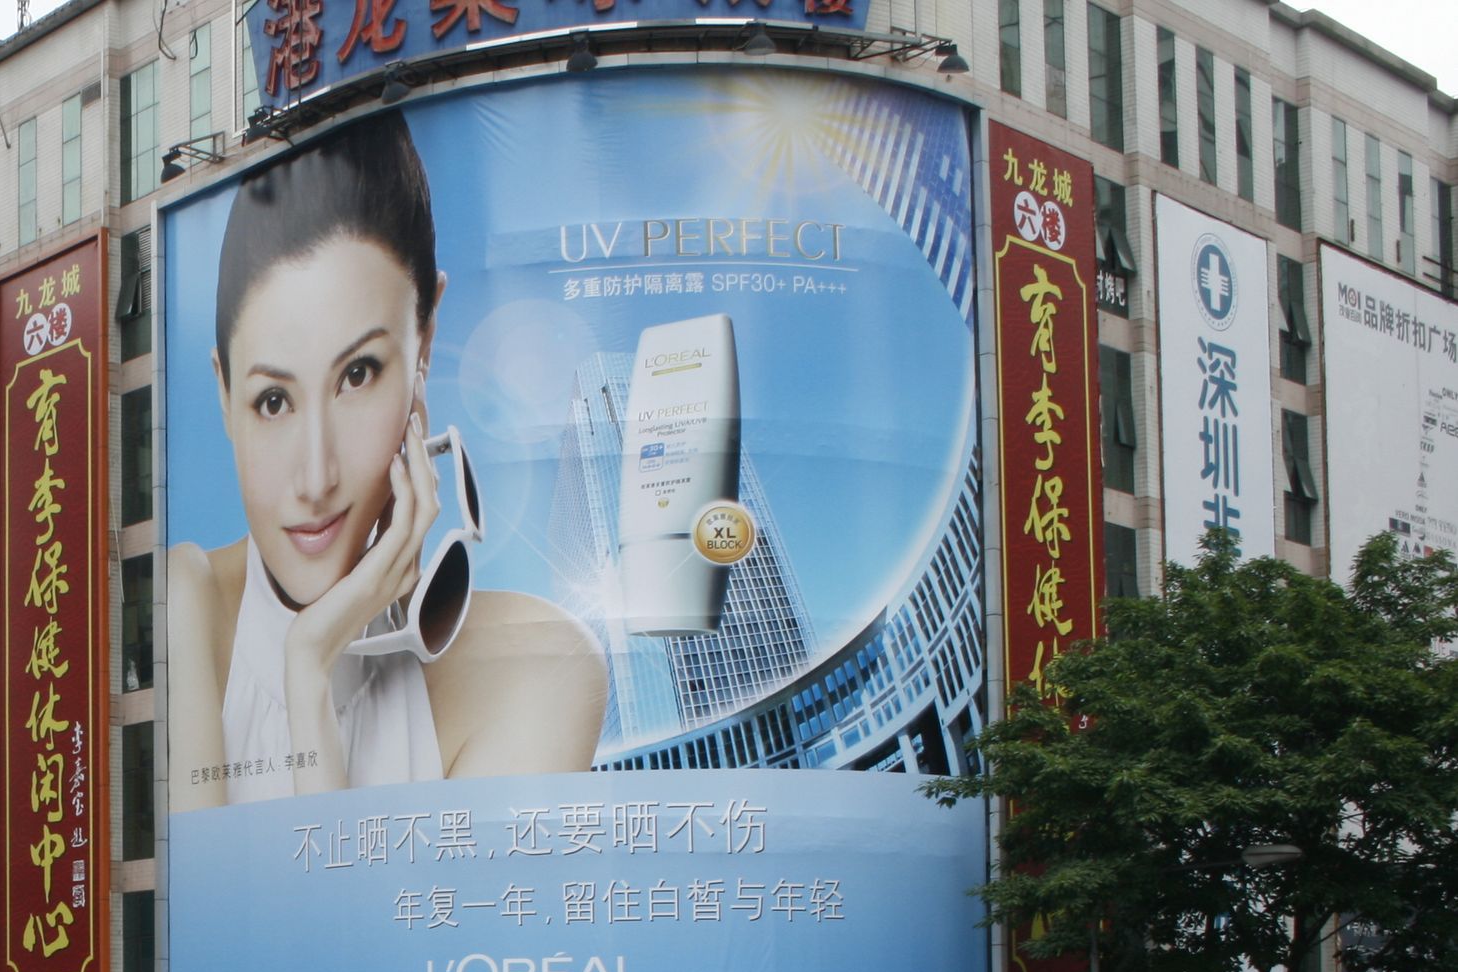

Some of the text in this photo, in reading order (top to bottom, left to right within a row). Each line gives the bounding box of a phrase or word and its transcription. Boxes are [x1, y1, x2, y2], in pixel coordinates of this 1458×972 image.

[1002, 147, 1074, 207] 九龙城
[560, 217, 847, 263] UV PERFECT
[15, 263, 81, 320] 九龙城
[563, 271, 848, 300] 多重防护隔离露 SPF30+ PA+++
